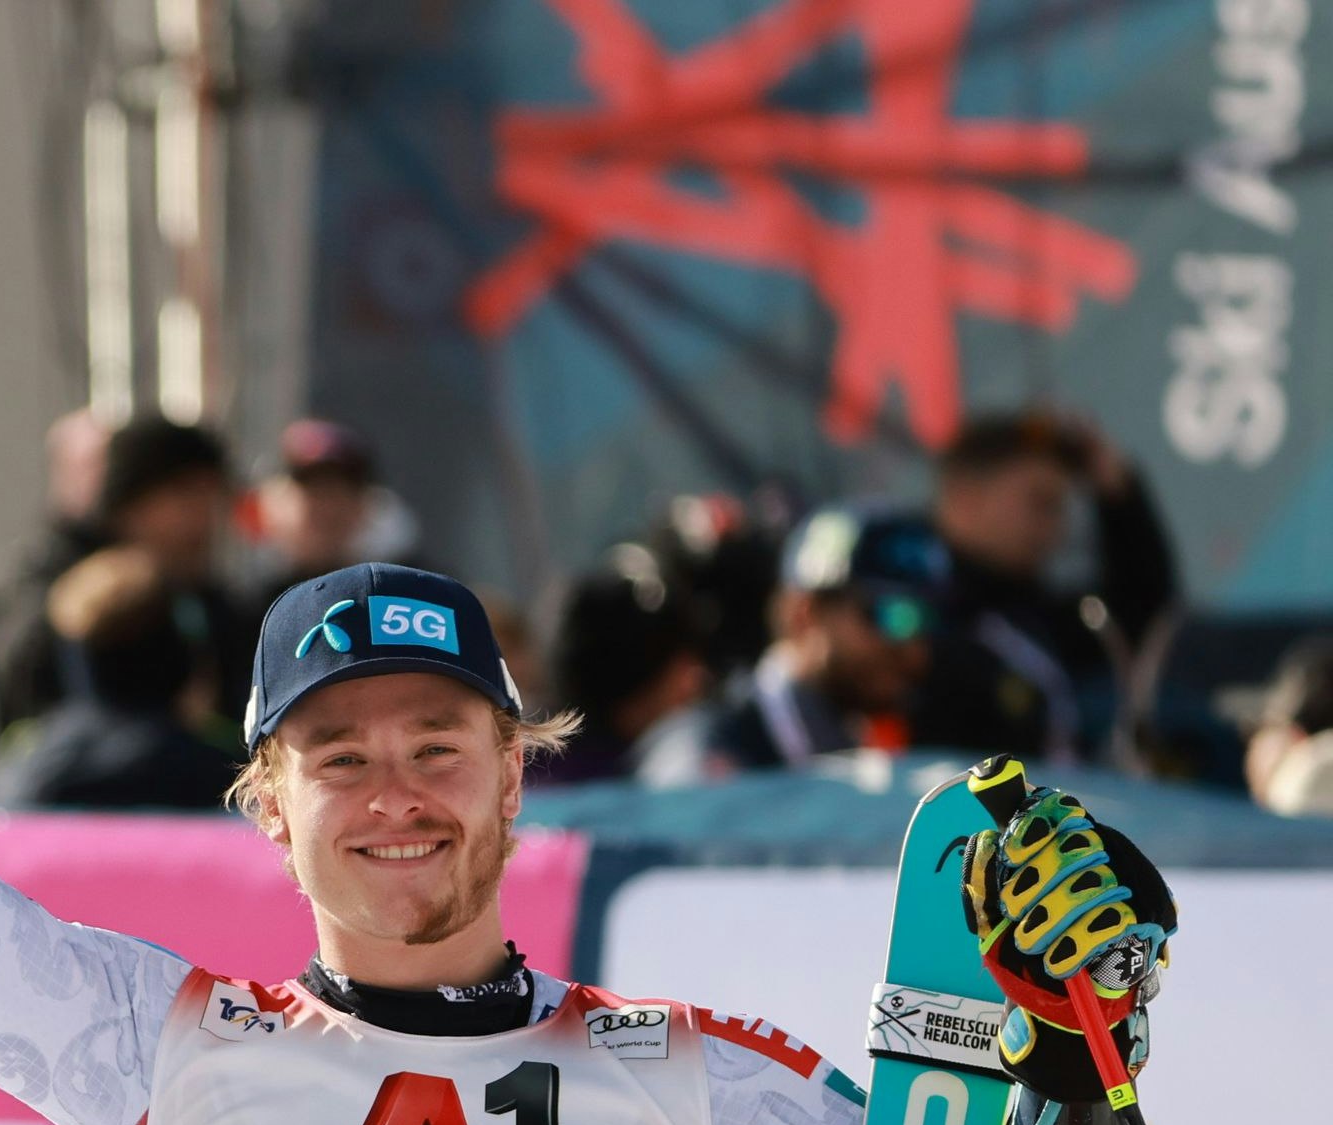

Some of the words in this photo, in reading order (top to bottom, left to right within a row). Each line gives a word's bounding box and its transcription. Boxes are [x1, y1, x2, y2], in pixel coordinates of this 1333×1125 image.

[1162, 253, 1292, 466] Ski
[381, 604, 446, 641] 5G
[926, 1011, 1000, 1038] REBELSCLU
[617, 1039, 643, 1049] World
[644, 1039, 662, 1048] Cup
[923, 1026, 992, 1052] HEAD.COM
